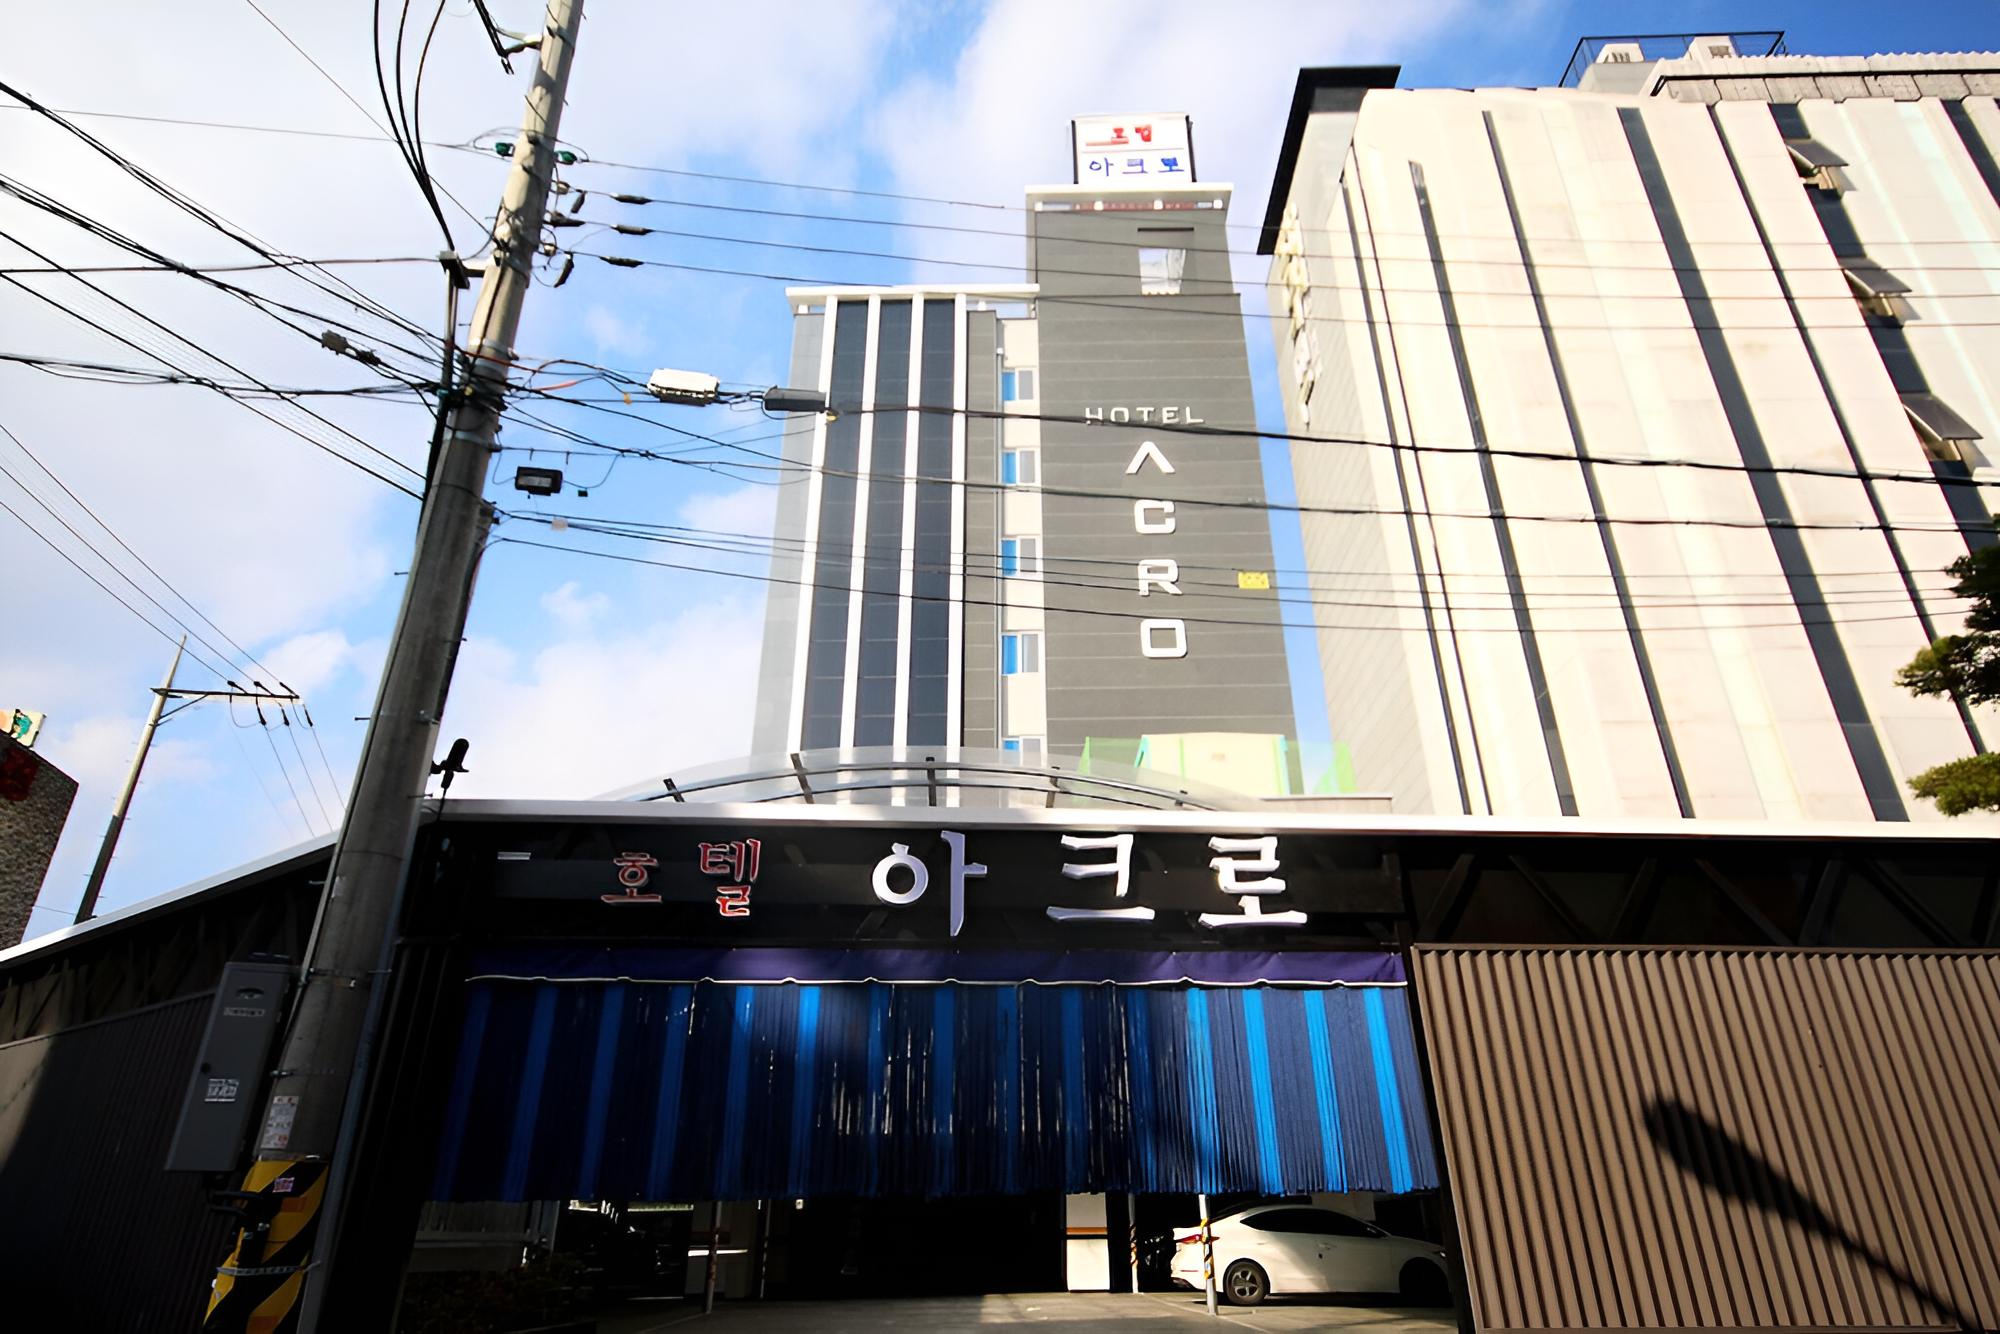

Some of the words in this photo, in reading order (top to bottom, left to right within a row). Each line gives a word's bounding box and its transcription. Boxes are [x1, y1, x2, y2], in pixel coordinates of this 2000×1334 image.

[1084, 405, 1204, 425] HOTEL
[1125, 440, 1188, 659] ACRO
[600, 838, 762, 918] 호텔
[871, 829, 1308, 938] 아크로
